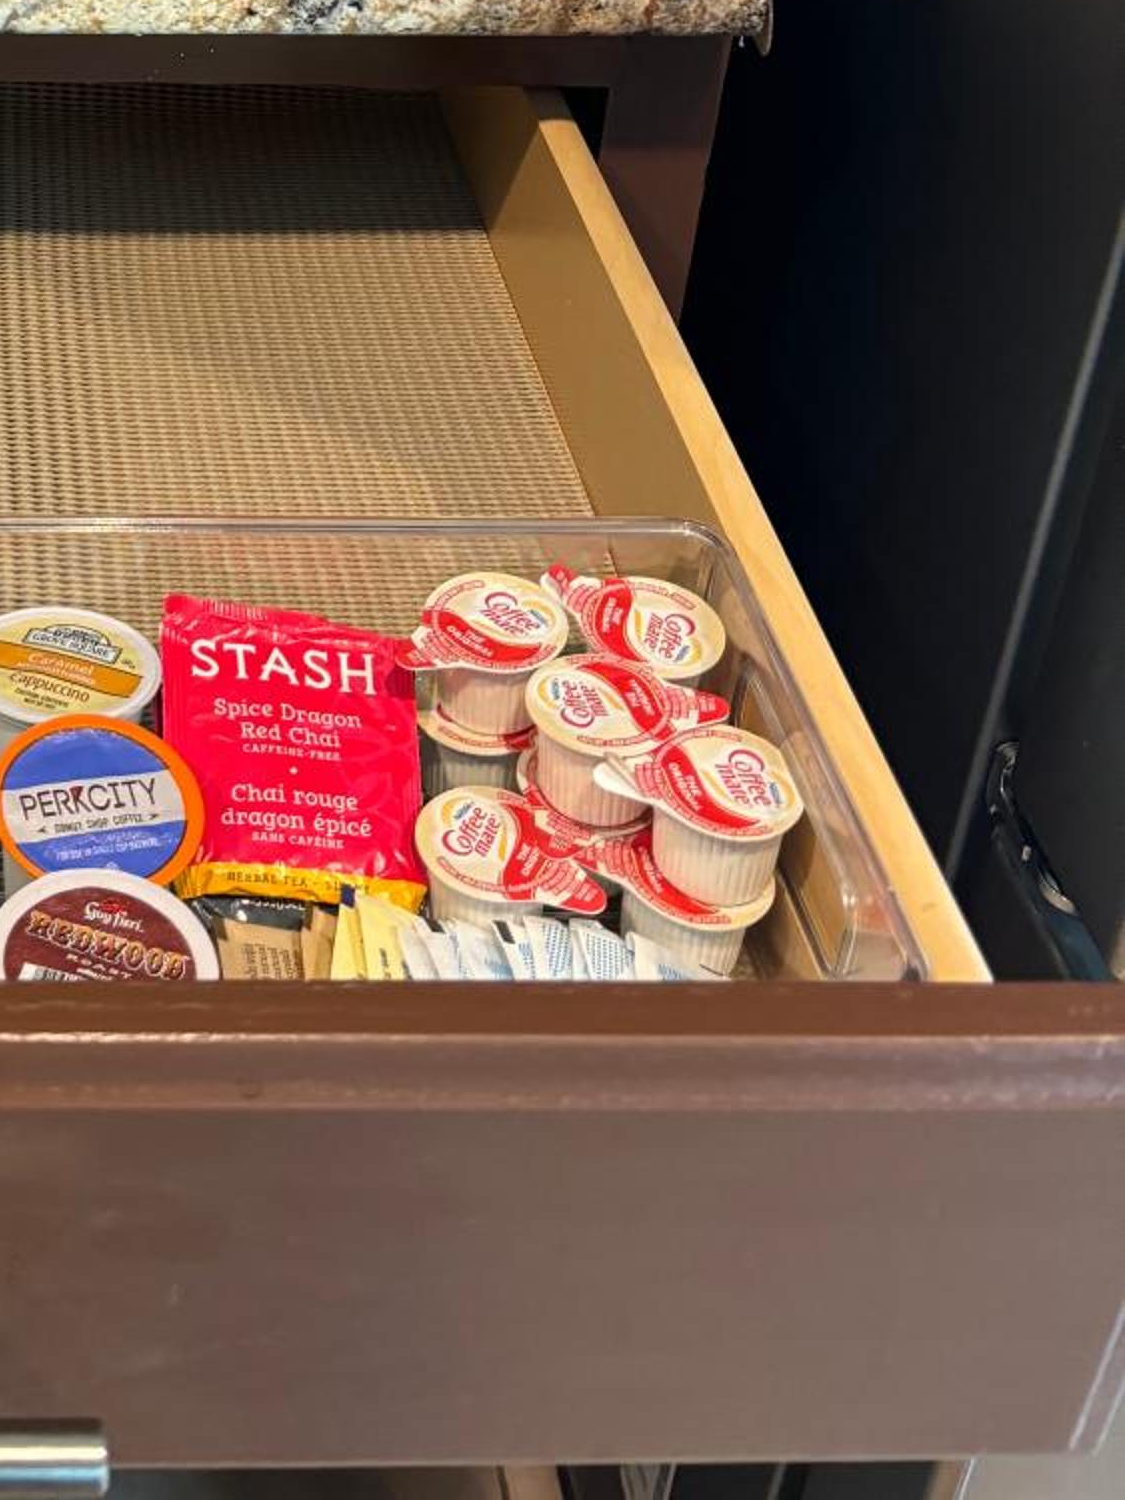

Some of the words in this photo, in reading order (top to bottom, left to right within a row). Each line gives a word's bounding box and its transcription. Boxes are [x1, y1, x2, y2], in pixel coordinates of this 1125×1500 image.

[484, 591, 540, 631] Coffee
[659, 613, 696, 659] Coffee
[190, 638, 377, 695] STASH
[213, 697, 274, 721] Spice
[280, 701, 363, 730] Dragon
[560, 680, 597, 728] Coffee
[240, 721, 281, 742] Red
[289, 726, 342, 749] Chai
[242, 742, 342, 761] CAFFEINE-FREE
[728, 748, 772, 807] Coffee
[231, 783, 286, 804] Chai
[292, 788, 360, 813] rouge
[220, 807, 305, 831] dragon
[313, 809, 373, 838] épicé
[251, 830, 287, 844] SANS
[442, 806, 488, 856] Coffee
[226, 871, 278, 885] HERBAL
[85, 901, 114, 925] Guy
[26, 910, 191, 981] REDWOOD
